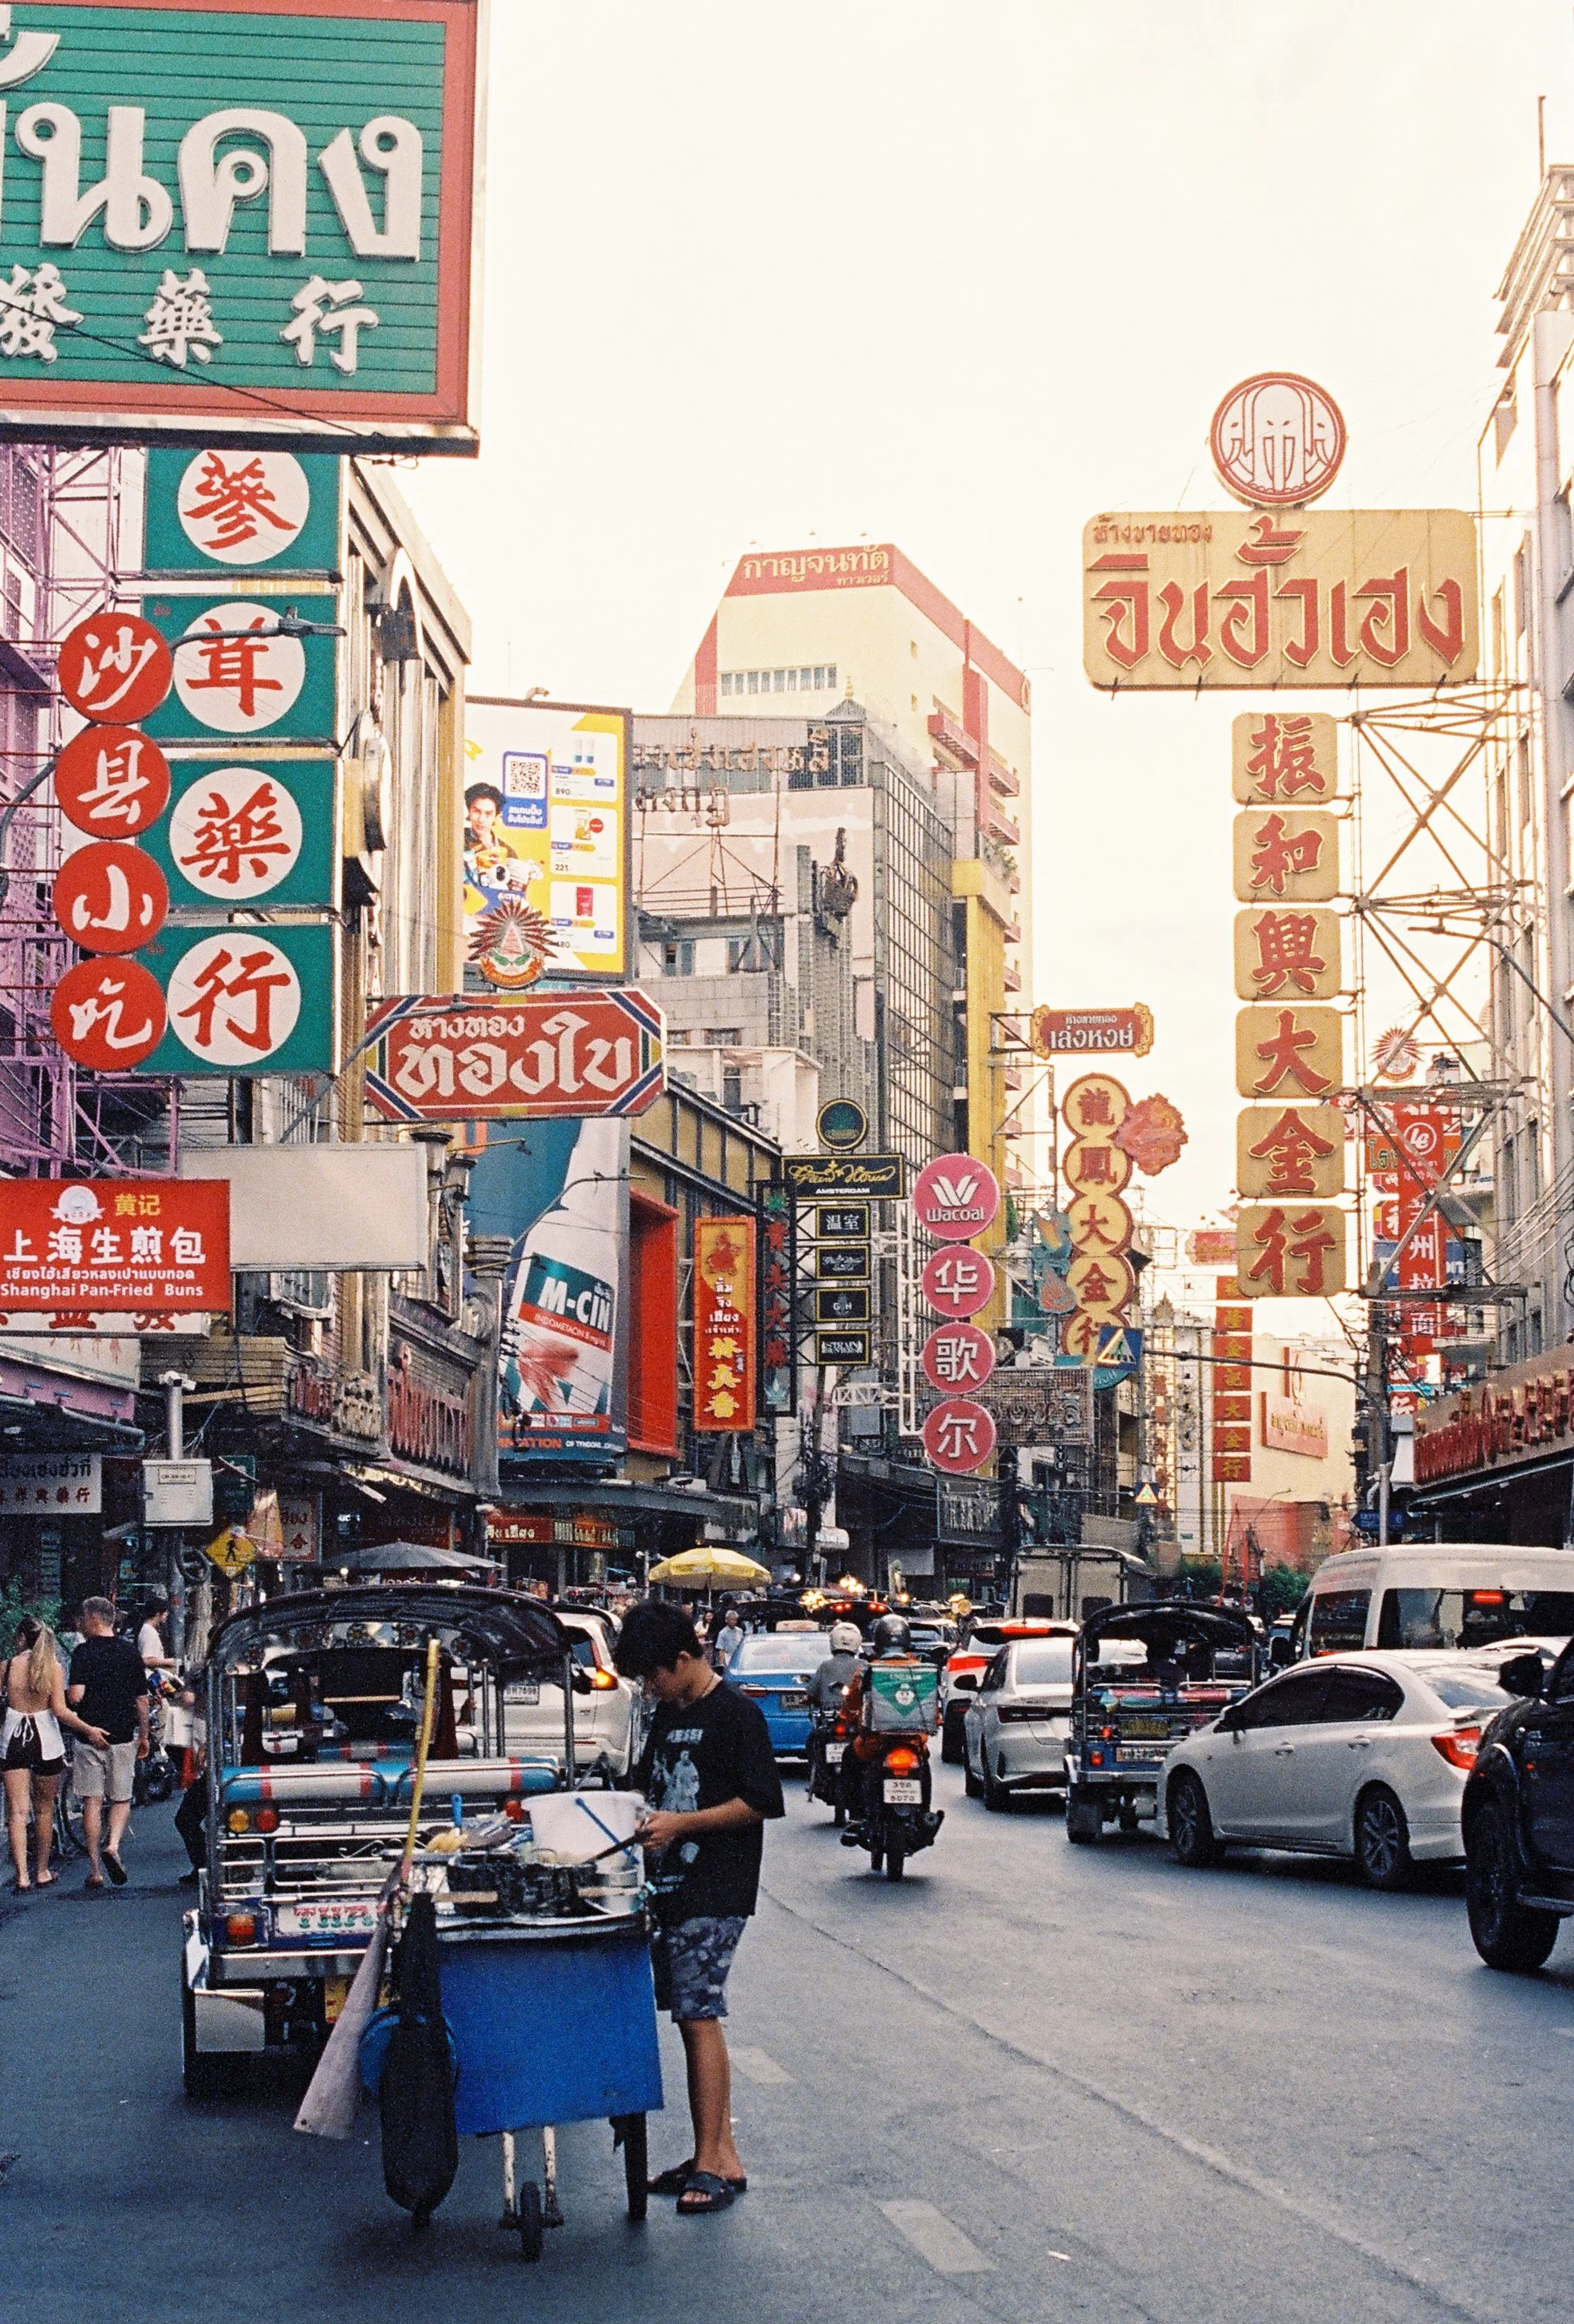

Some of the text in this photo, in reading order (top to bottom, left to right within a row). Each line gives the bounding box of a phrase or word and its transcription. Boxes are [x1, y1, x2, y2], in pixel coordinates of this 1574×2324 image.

[69, 626, 158, 1048] 沙县小吃
[114, 1193, 162, 1216] 黄记
[3, 1226, 206, 1264] 上海生煎包
[0, 1283, 204, 1299] Shanghai Pan-Fried Buns
[537, 1276, 611, 1332] M-CIN
[933, 1260, 981, 1458] 华歌尔
